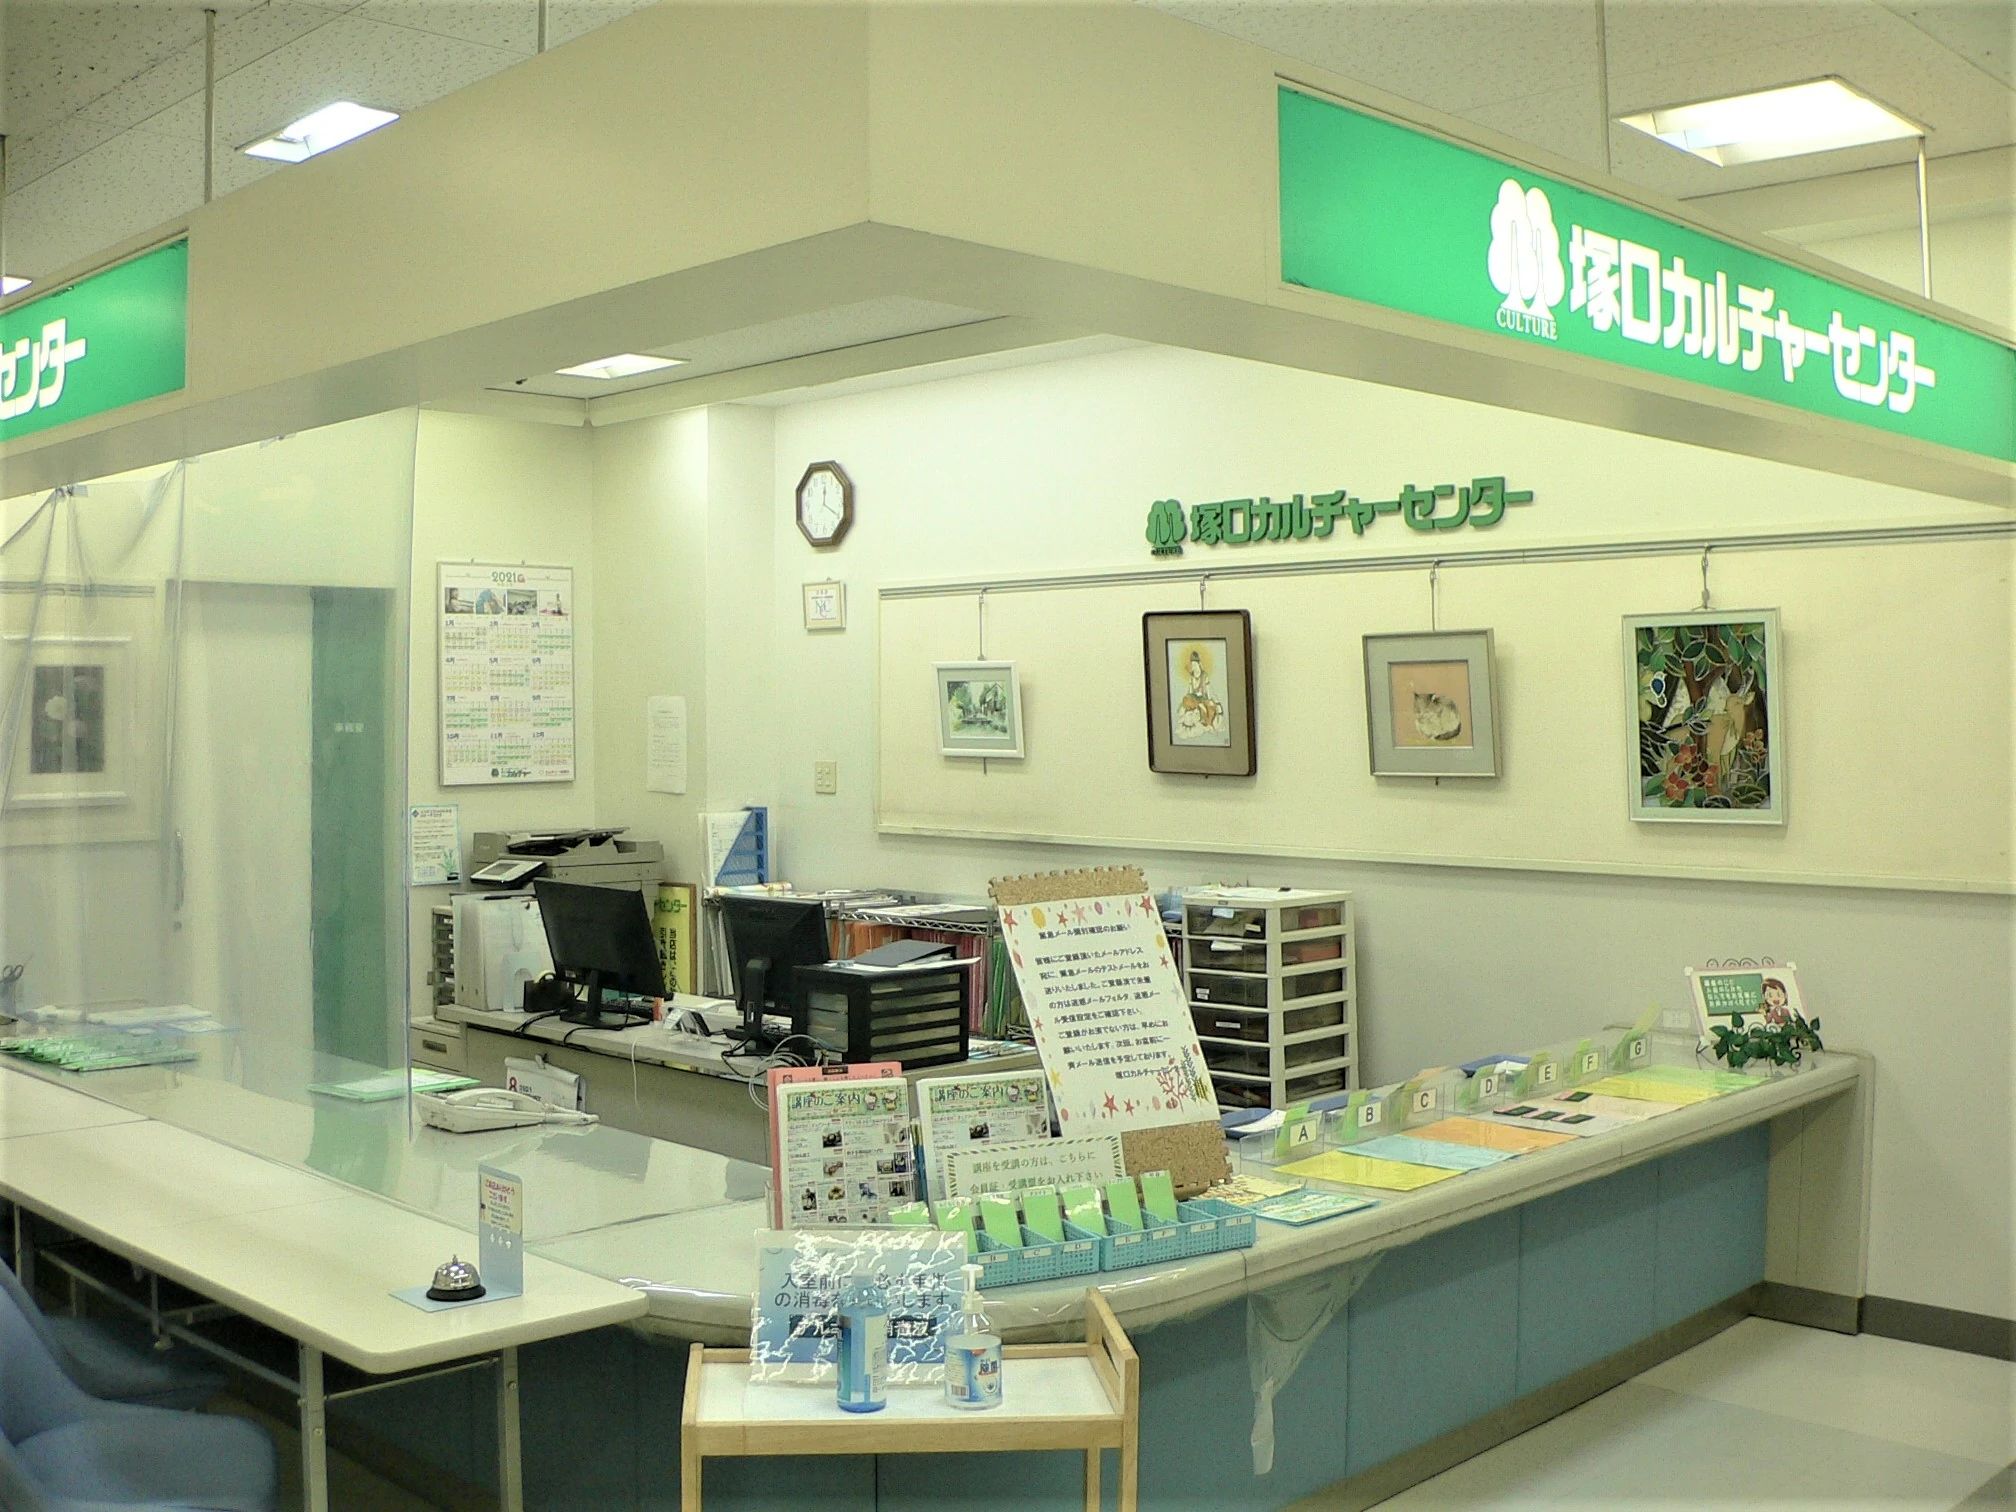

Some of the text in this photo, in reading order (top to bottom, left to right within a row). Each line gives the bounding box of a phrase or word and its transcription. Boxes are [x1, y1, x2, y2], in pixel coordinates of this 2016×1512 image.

[1496, 306, 1558, 340] CULTURE
[1569, 224, 1936, 413] 塚口カルチャーセンター
[1191, 476, 1534, 545] 塚口カルチャーセンター
[492, 572, 516, 582] 2021
[1635, 1042, 1642, 1055] G
[1587, 1056, 1594, 1070] F
[1544, 1067, 1551, 1081] E
[1485, 1079, 1493, 1093] D
[792, 1092, 861, 1109] 講座のご案内
[935, 1086, 1004, 1102] 講座のご案内
[1421, 1093, 1428, 1107] C
[1366, 1108, 1373, 1122] B
[1298, 1126, 1308, 1140] A
